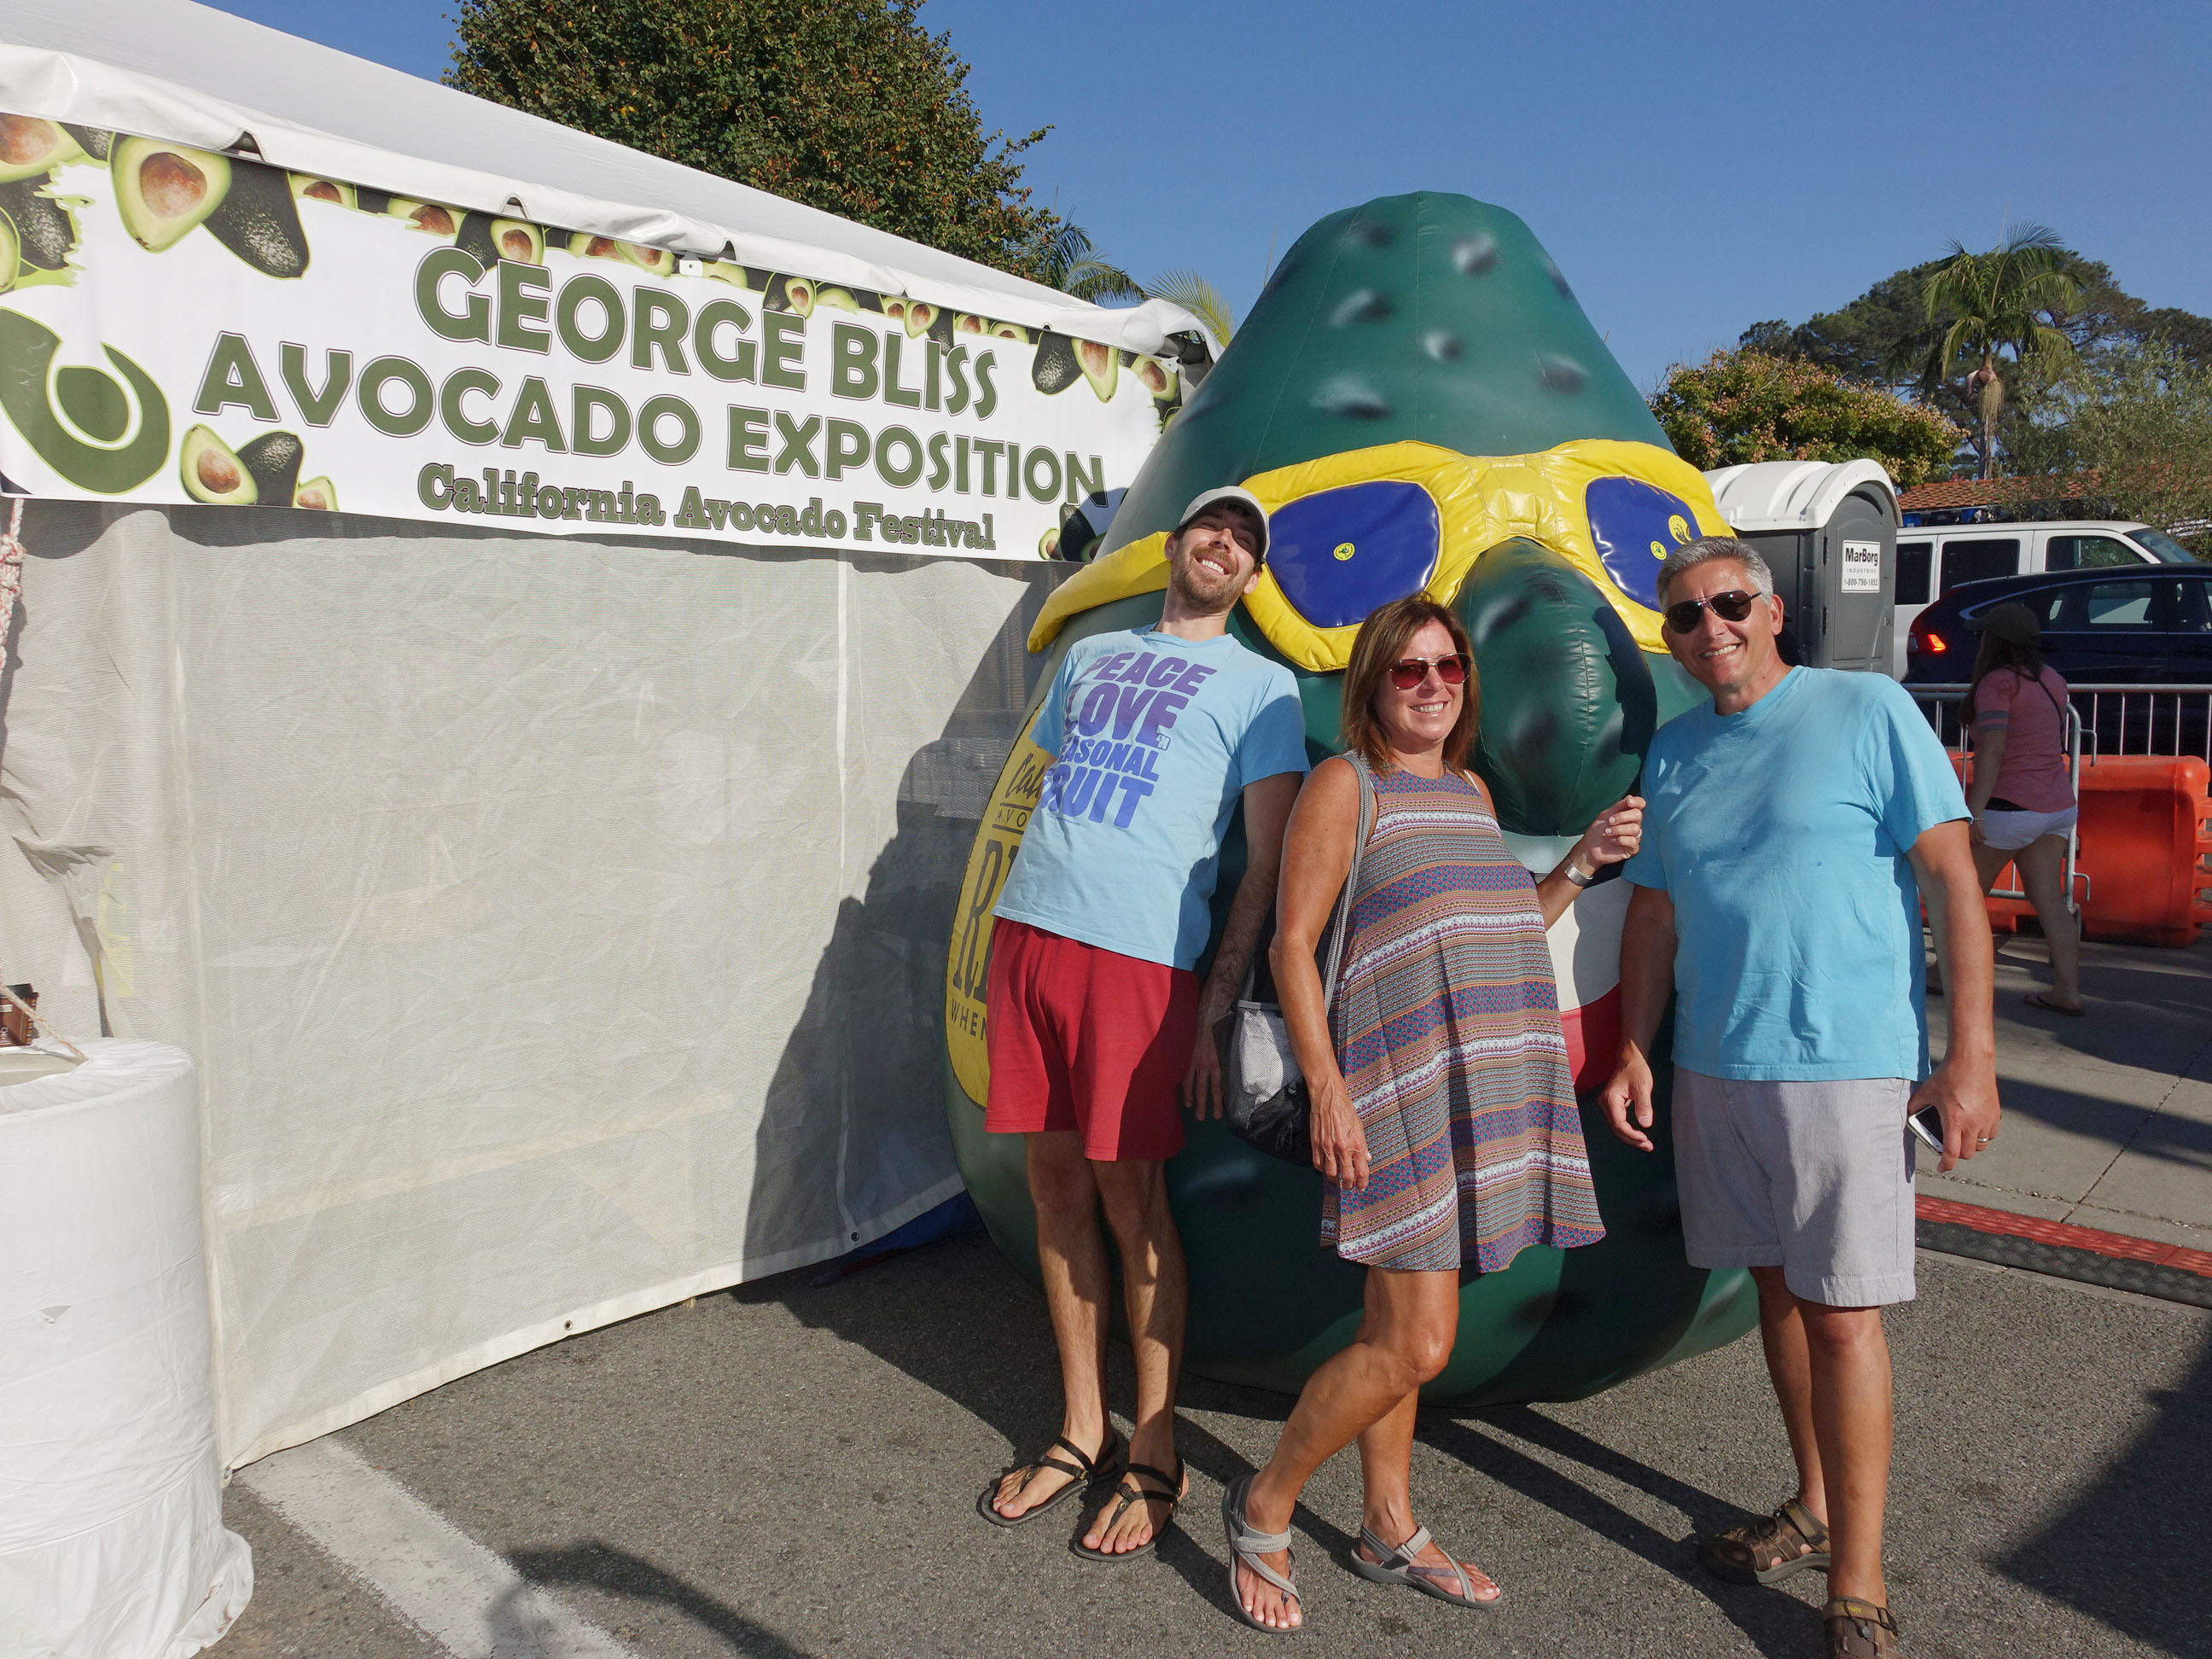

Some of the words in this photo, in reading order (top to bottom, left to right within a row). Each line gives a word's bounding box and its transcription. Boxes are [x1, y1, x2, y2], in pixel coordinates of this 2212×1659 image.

[414, 246, 807, 393] GEORGE
[830, 321, 998, 421] BLISS
[192, 330, 703, 466] AVOCADO
[726, 404, 1109, 508] EXPOSITION
[418, 463, 666, 527] California
[673, 486, 847, 539] Avocado
[853, 501, 996, 550] Festival
[1845, 547, 1878, 567] MarBorg
[1074, 652, 1218, 696] PEACE
[1058, 736, 1160, 782] EASONAL
